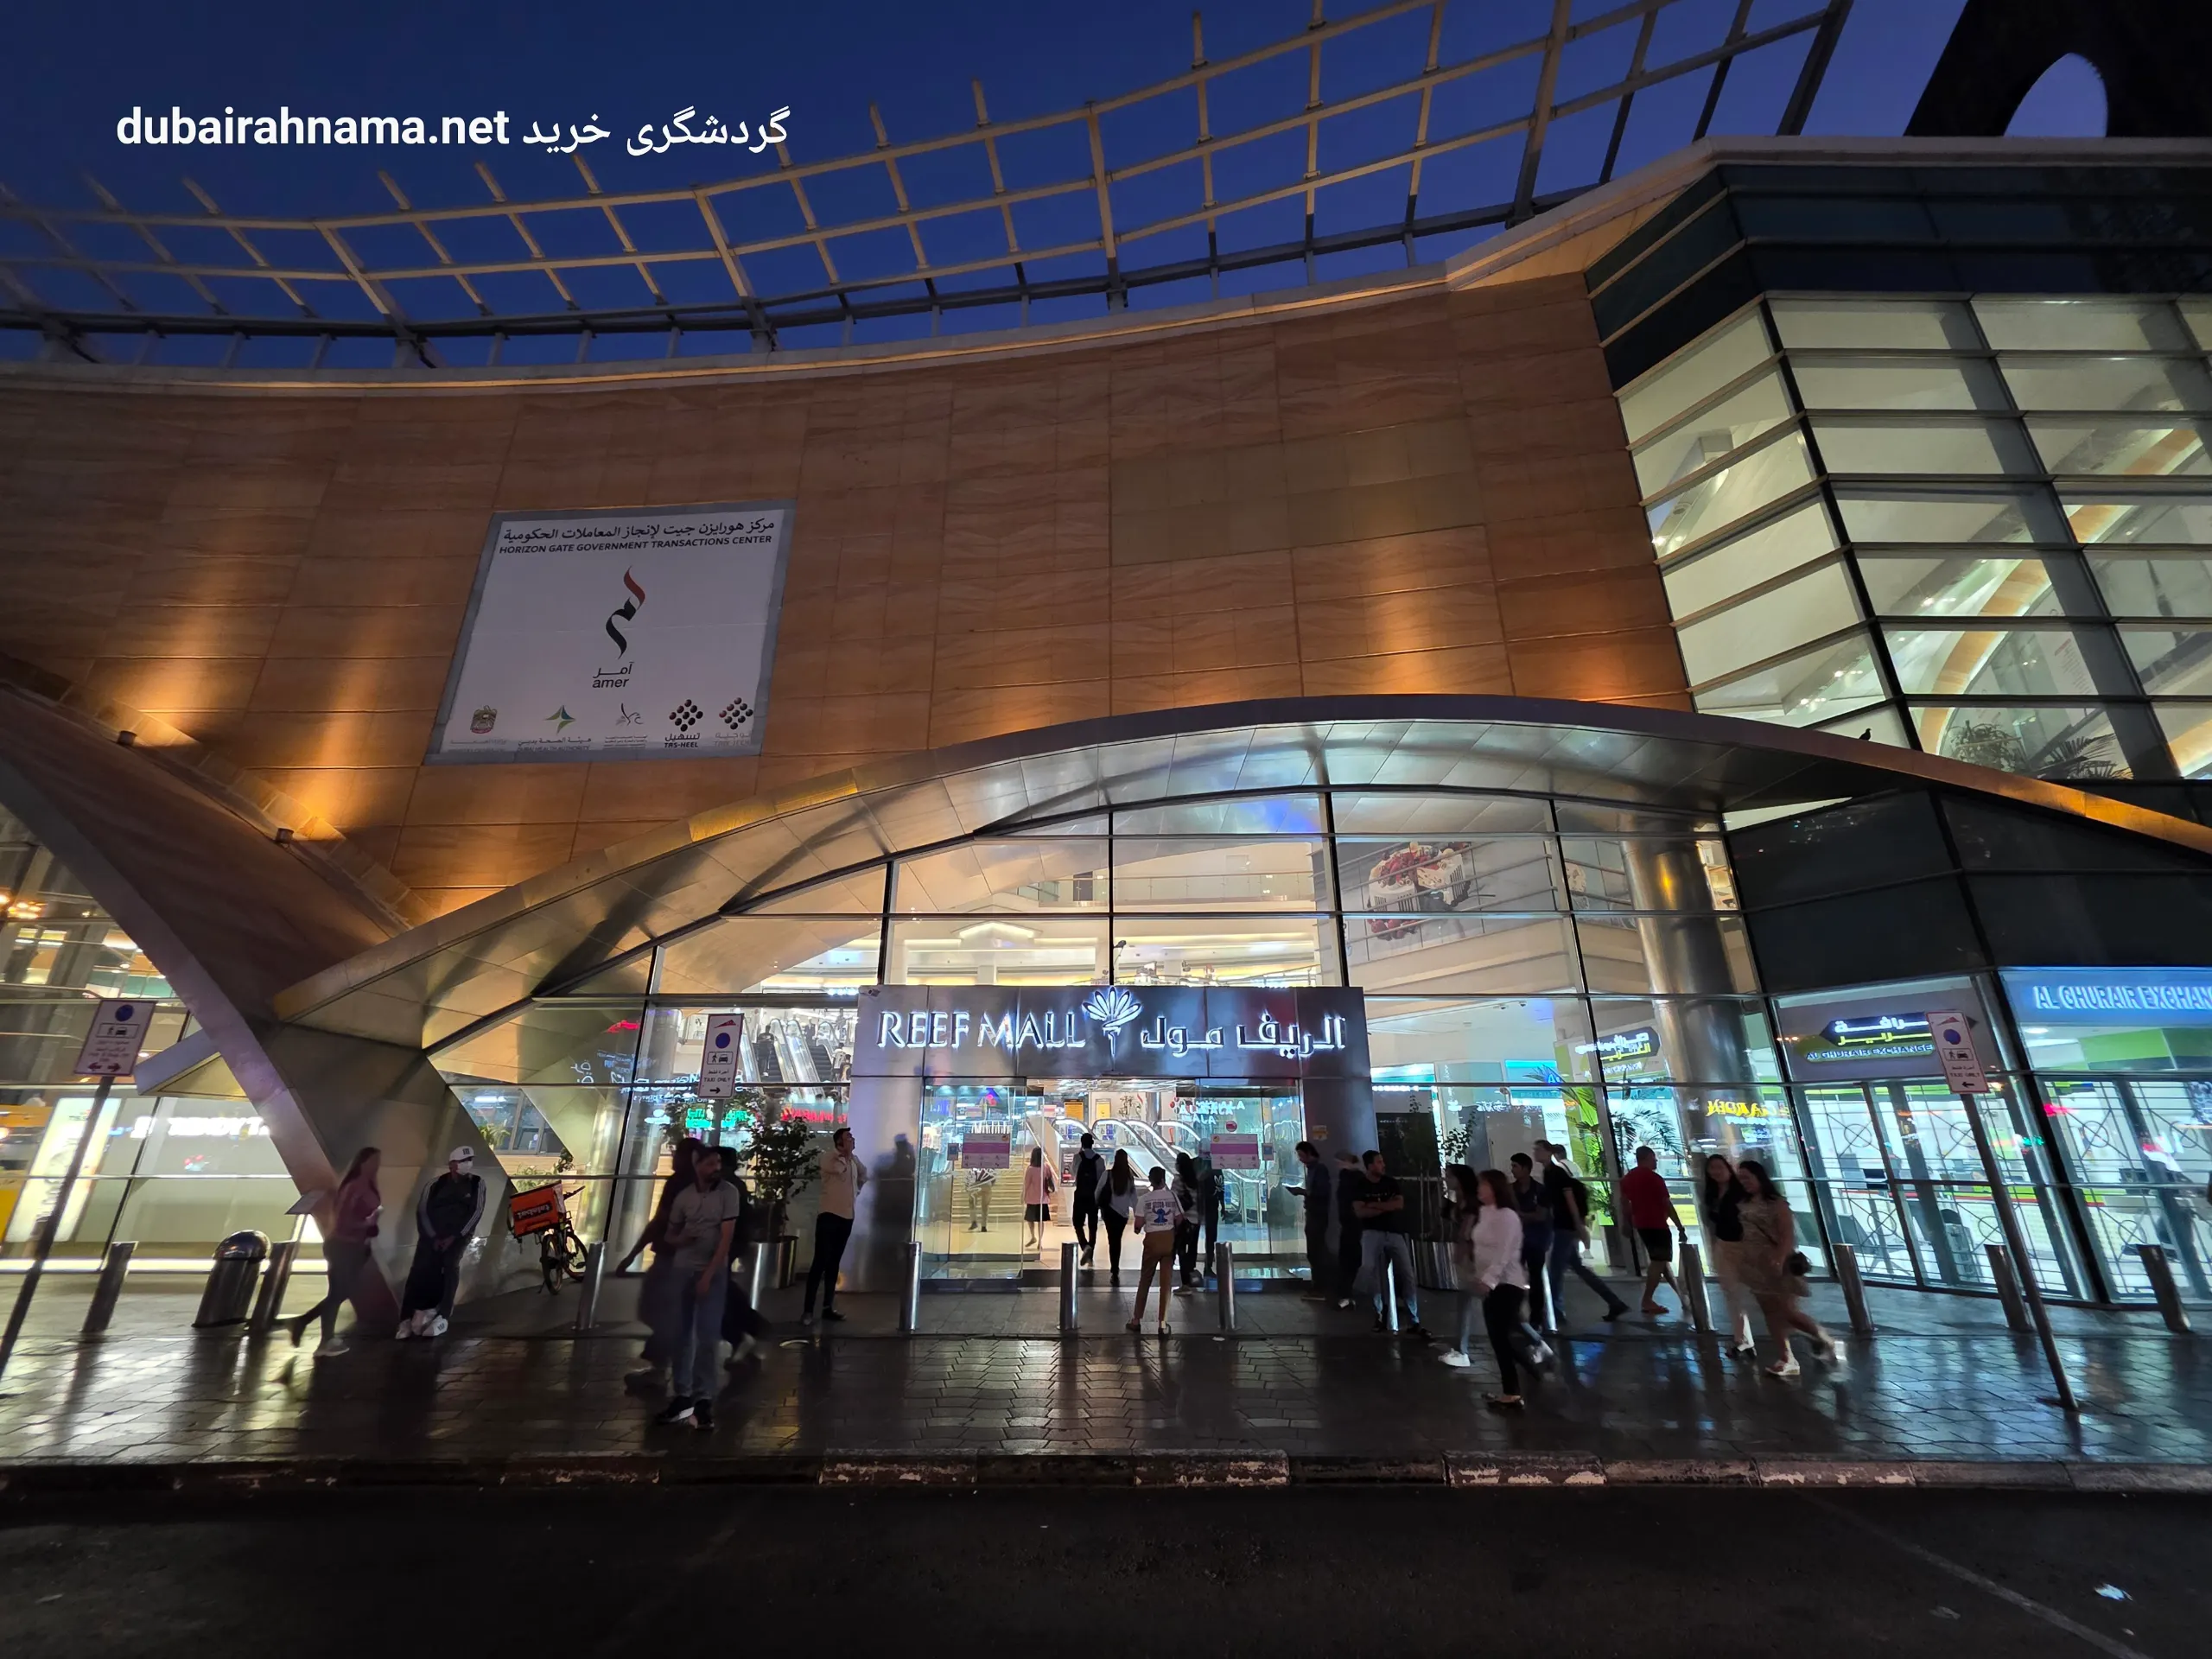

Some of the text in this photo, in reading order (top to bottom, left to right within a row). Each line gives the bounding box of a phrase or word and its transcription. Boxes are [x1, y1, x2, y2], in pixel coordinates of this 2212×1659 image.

[503, 518, 775, 544] مركز هورايزن جيت لإنجاز المعاملات الحكومية
[499, 535, 772, 555] HORIZON GATE GOVERNMENT TRANSACTIONS CENTER
[592, 678, 630, 689] amer
[664, 732, 701, 742] تسهيل
[2032, 985, 2060, 1009] AL
[2057, 985, 2143, 1010] GHURAIR
[878, 1009, 1087, 1049] REEF MALL
[1140, 1010, 1347, 1058] الريف مول
[1872, 1044, 1935, 1056] EXCHANGE
